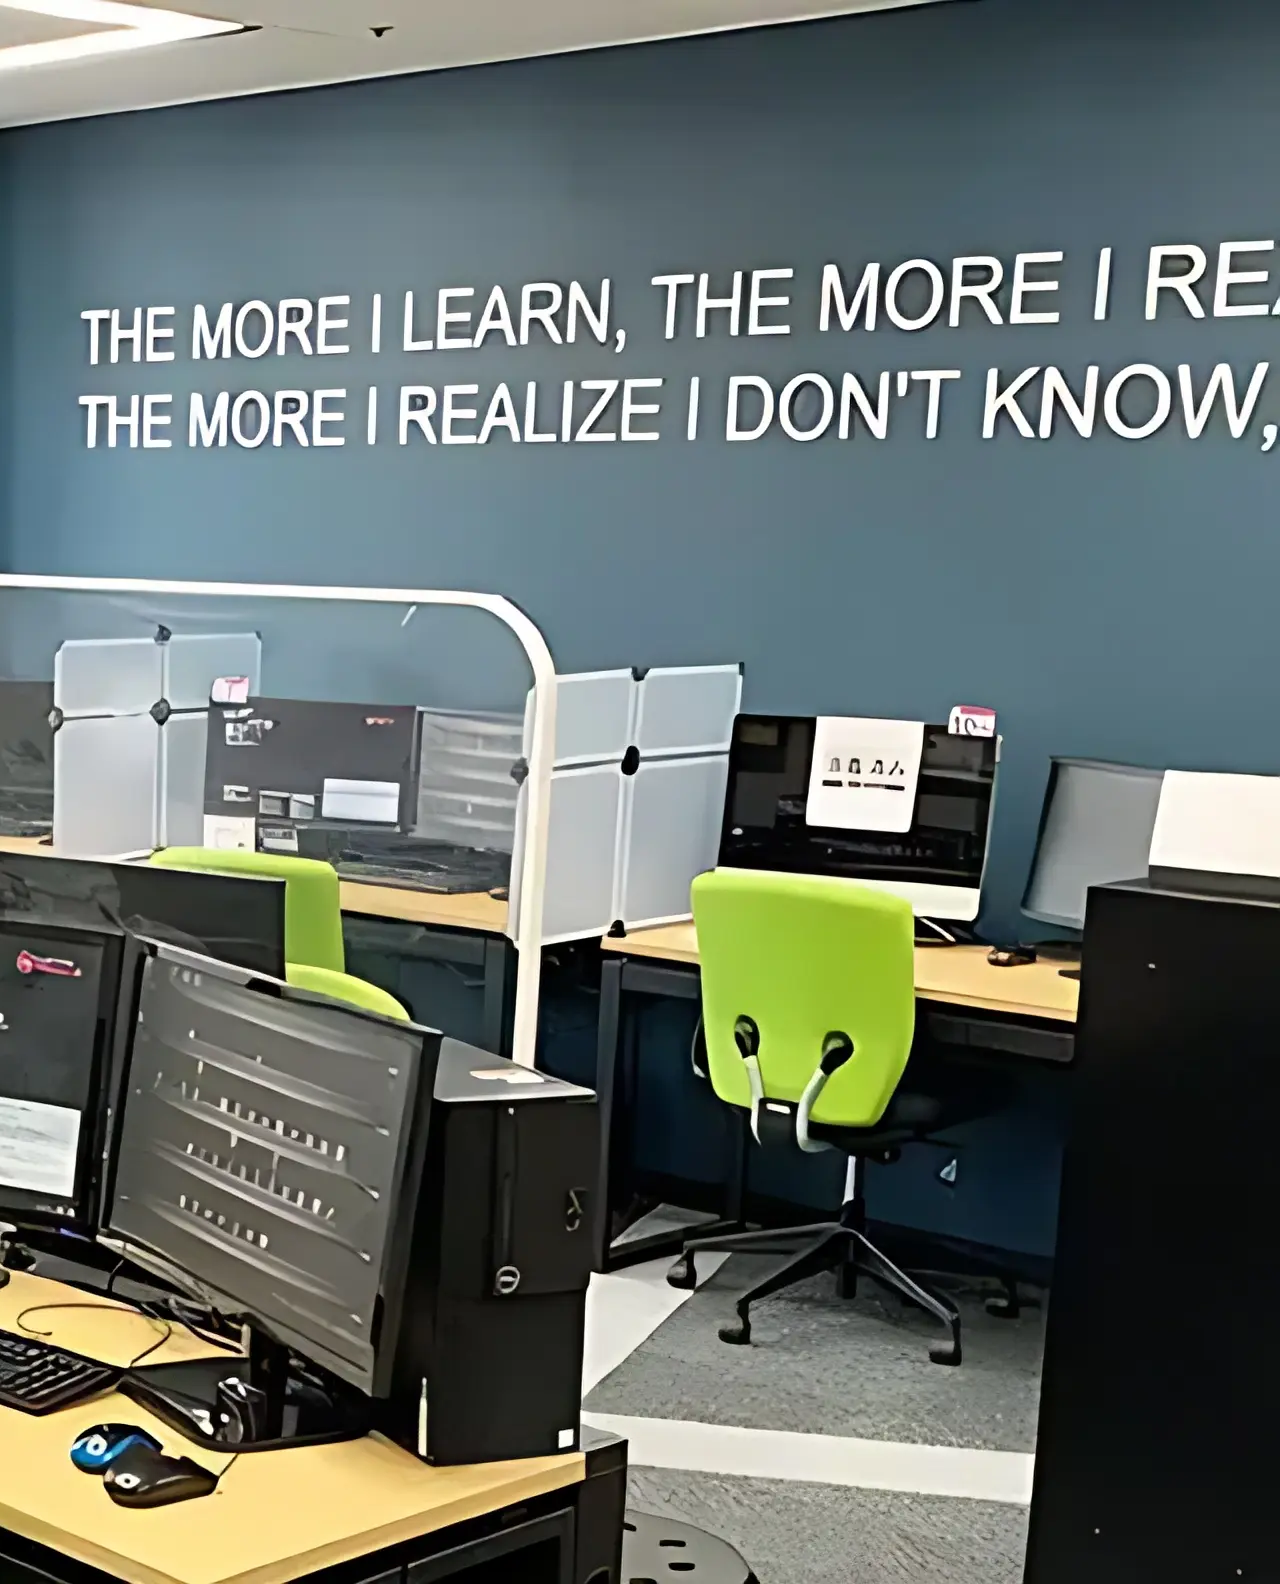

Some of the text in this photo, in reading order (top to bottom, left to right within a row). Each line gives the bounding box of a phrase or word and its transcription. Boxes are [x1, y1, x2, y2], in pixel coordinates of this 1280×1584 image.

[80, 239, 1280, 366] THE MORE I LEARN, THE MORE I RE
[78, 360, 1278, 453] THE MORE I REALIZE I DON'T KNOW,
